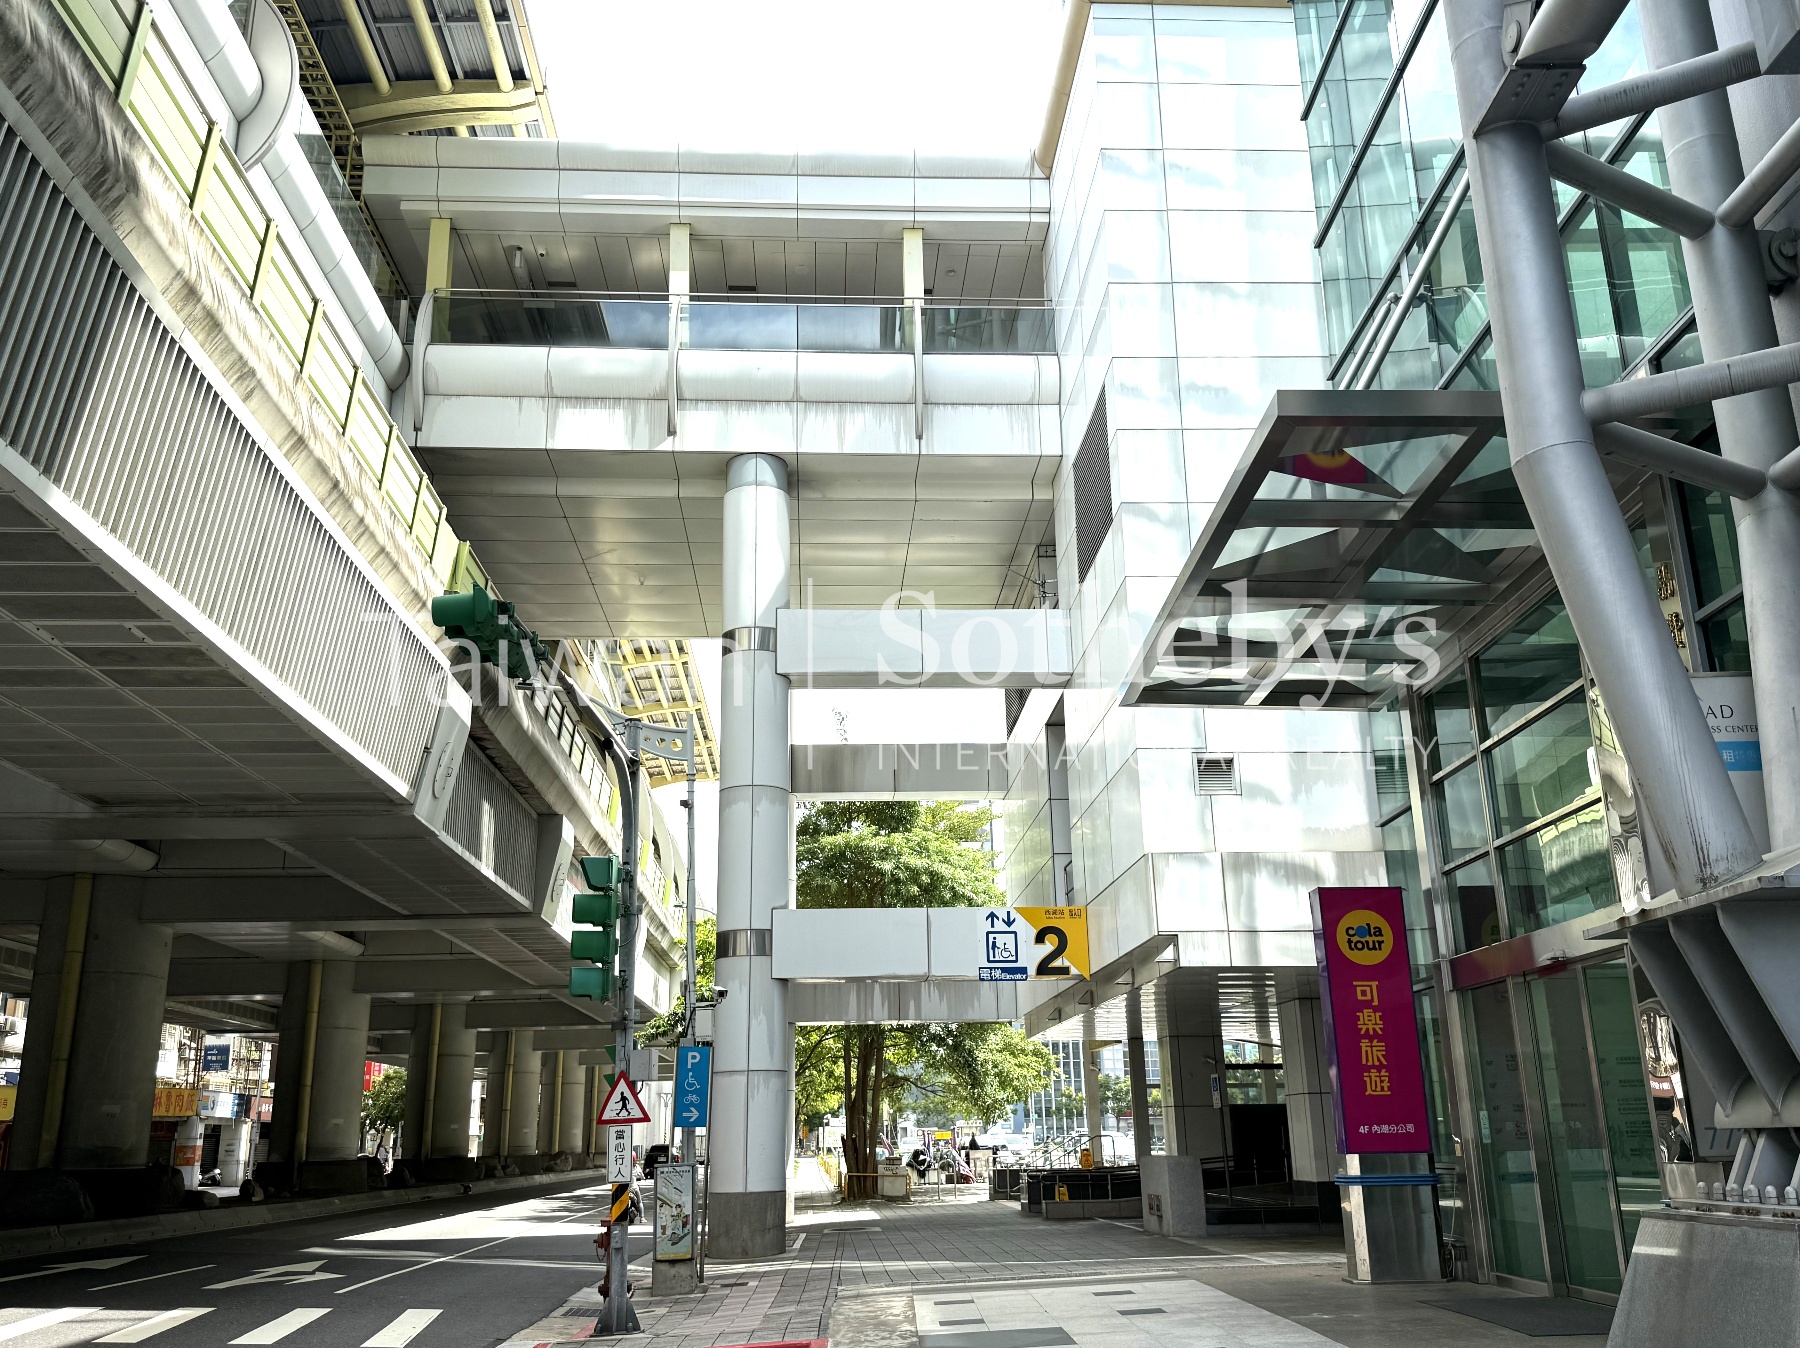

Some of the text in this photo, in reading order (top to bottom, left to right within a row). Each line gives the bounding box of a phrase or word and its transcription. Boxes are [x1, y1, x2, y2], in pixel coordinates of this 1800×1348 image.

[1345, 922, 1384, 937] cola
[1034, 926, 1071, 977] 2
[1346, 937, 1385, 951] tour
[979, 968, 1001, 980] 電梯
[687, 1051, 701, 1069] P
[1358, 1125, 1370, 1134] 4F
[614, 1129, 626, 1179] 當心行人
